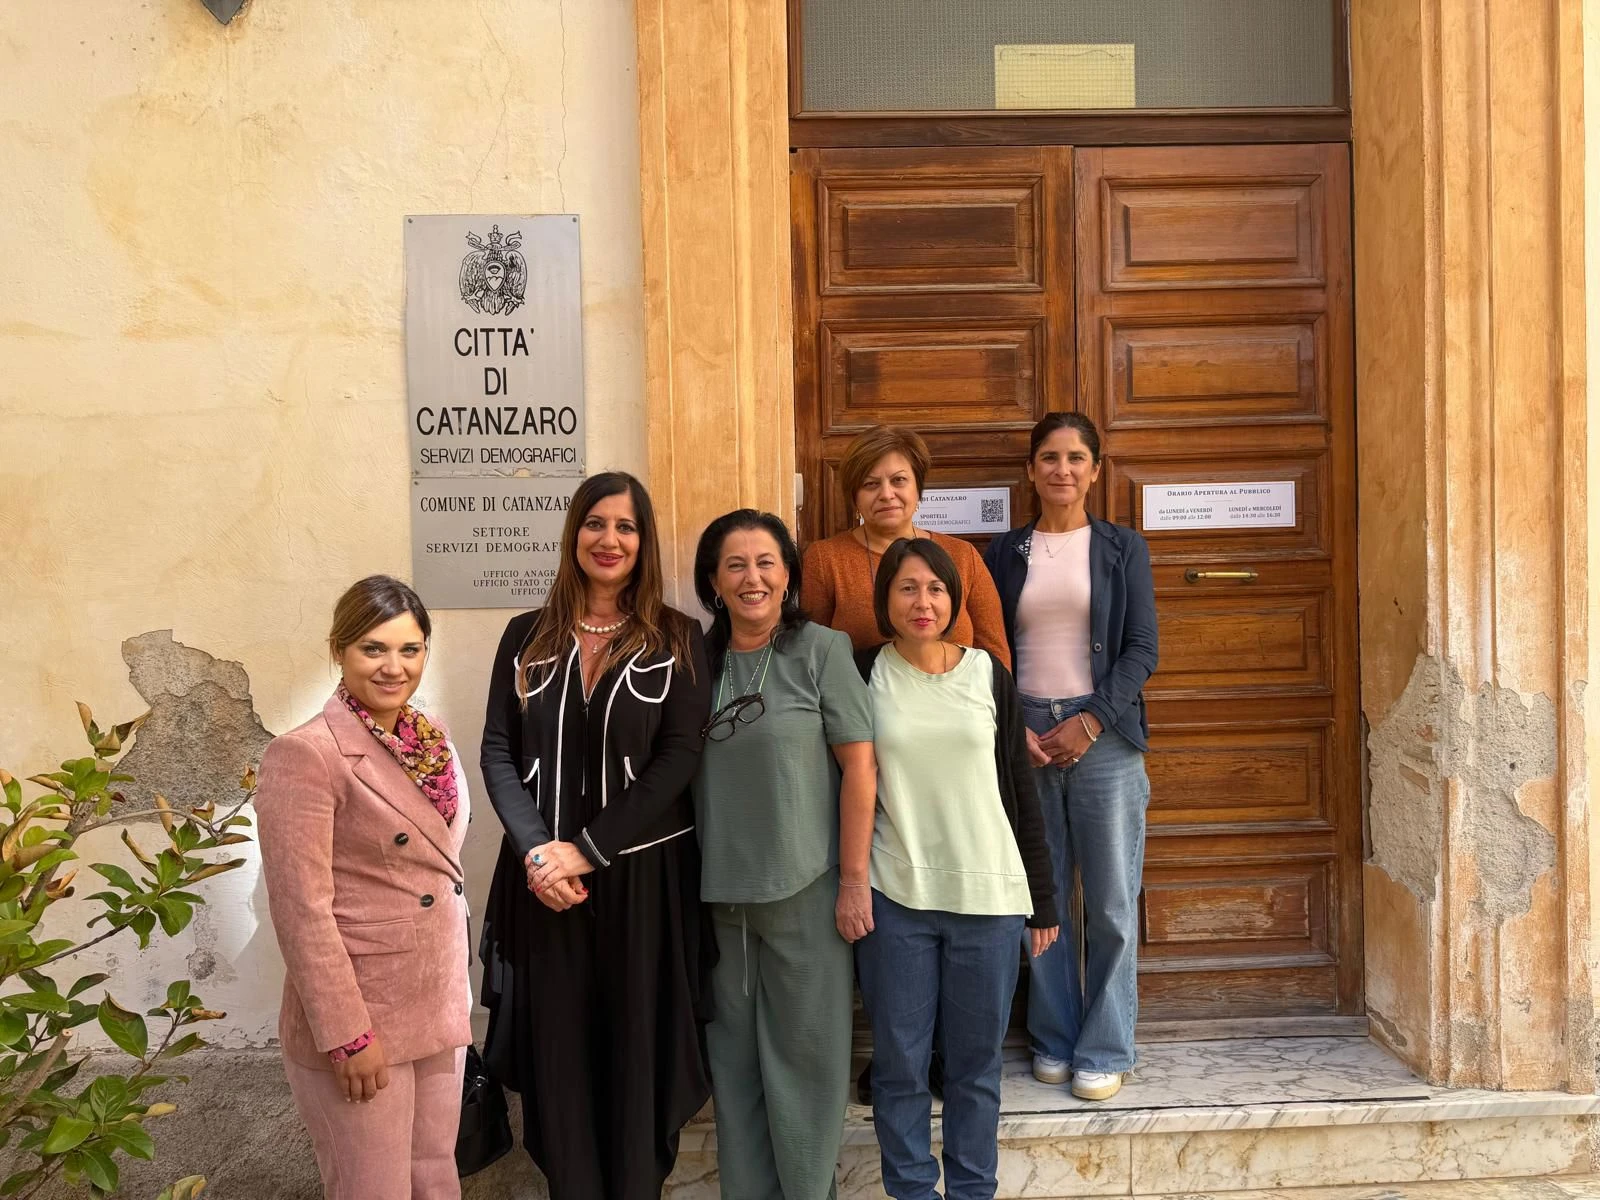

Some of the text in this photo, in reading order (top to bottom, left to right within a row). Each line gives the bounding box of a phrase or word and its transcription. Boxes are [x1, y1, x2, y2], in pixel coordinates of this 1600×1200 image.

[454, 327, 535, 357] CITTA'
[484, 367, 508, 396] DI
[416, 406, 578, 436] CATANZARO
[420, 447, 577, 464] SERVIZI DEMOGRAFICI
[420, 496, 571, 512] COMUNE DI CATANZAR
[472, 527, 530, 537] SETTORE
[426, 542, 561, 553] SERVIZI DEMOGRAF
[484, 569, 556, 578] UFFICIO ANAGR
[473, 579, 509, 587] UFFICIO
[513, 579, 540, 587] STATO
[511, 587, 547, 595] UFFICIO
